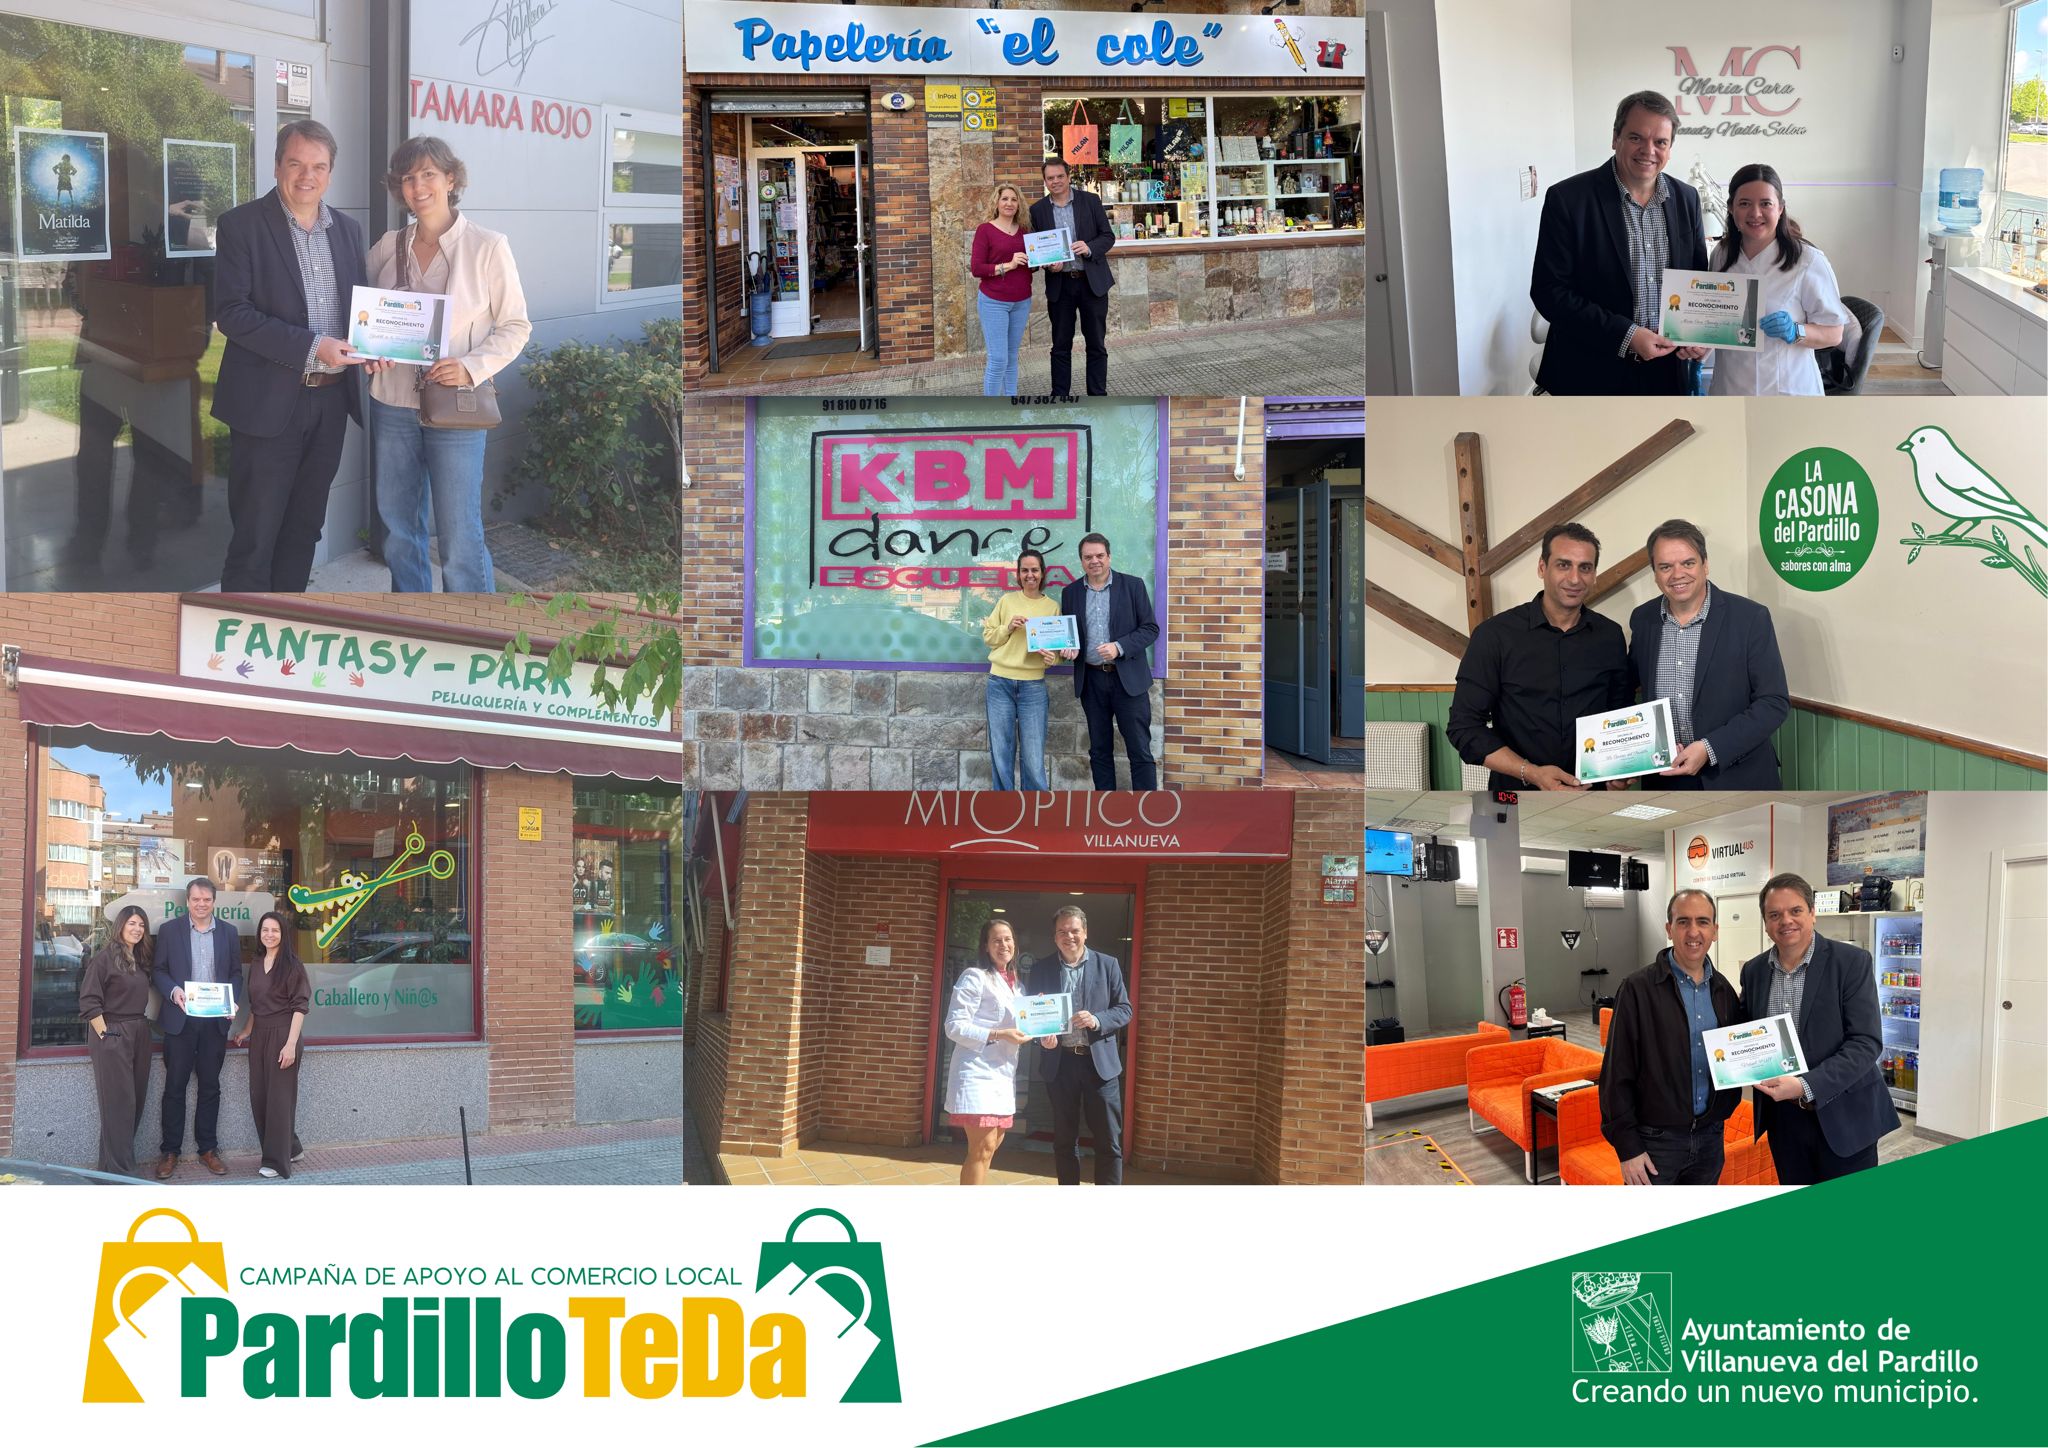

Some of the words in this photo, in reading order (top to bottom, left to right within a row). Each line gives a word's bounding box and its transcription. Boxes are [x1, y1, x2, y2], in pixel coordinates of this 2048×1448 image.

[735, 17, 953, 71] Papelería
[1678, 76, 1743, 95] Maria
[1745, 77, 1795, 95] Cara
[410, 80, 524, 130] TAMARA
[531, 100, 592, 139] ROJO
[1675, 124, 1717, 139] eauty
[1717, 121, 1762, 137] Nails
[1763, 121, 1807, 137] Salon
[1071, 136, 1089, 156] MILAN
[1118, 137, 1135, 155] MILAN
[1163, 132, 1183, 154] MILAN
[39, 213, 91, 229] Matilda
[1688, 301, 1739, 311] RECONOCIMIENTO
[375, 318, 425, 329] RECONOCIMIENTO
[822, 399, 836, 411] 91
[837, 399, 856, 411] 810
[841, 447, 1054, 502] KBM
[1805, 460, 1823, 483] LA
[1775, 481, 1858, 519] CASONA
[828, 512, 1064, 560] dance
[1774, 521, 1795, 543] del
[1798, 517, 1860, 542] Pardillo
[1780, 560, 1812, 572] sabores
[1812, 562, 1828, 572] con
[1829, 560, 1851, 572] alma
[214, 618, 427, 678] FANTASY
[431, 690, 528, 712] PELUQUERÍA
[533, 702, 543, 713] Y
[547, 704, 659, 728] COMPLEMENTOS
[1602, 732, 1650, 746] RECONOCIMIENTO
[1084, 834, 1181, 848] VILLANUEVA
[1325, 877, 1355, 885] Alarma
[314, 987, 379, 1007] Caballero
[383, 992, 391, 1011] y
[394, 987, 438, 1008] Niñ@s
[1731, 1042, 1776, 1056] RECONOCIMIENTO
